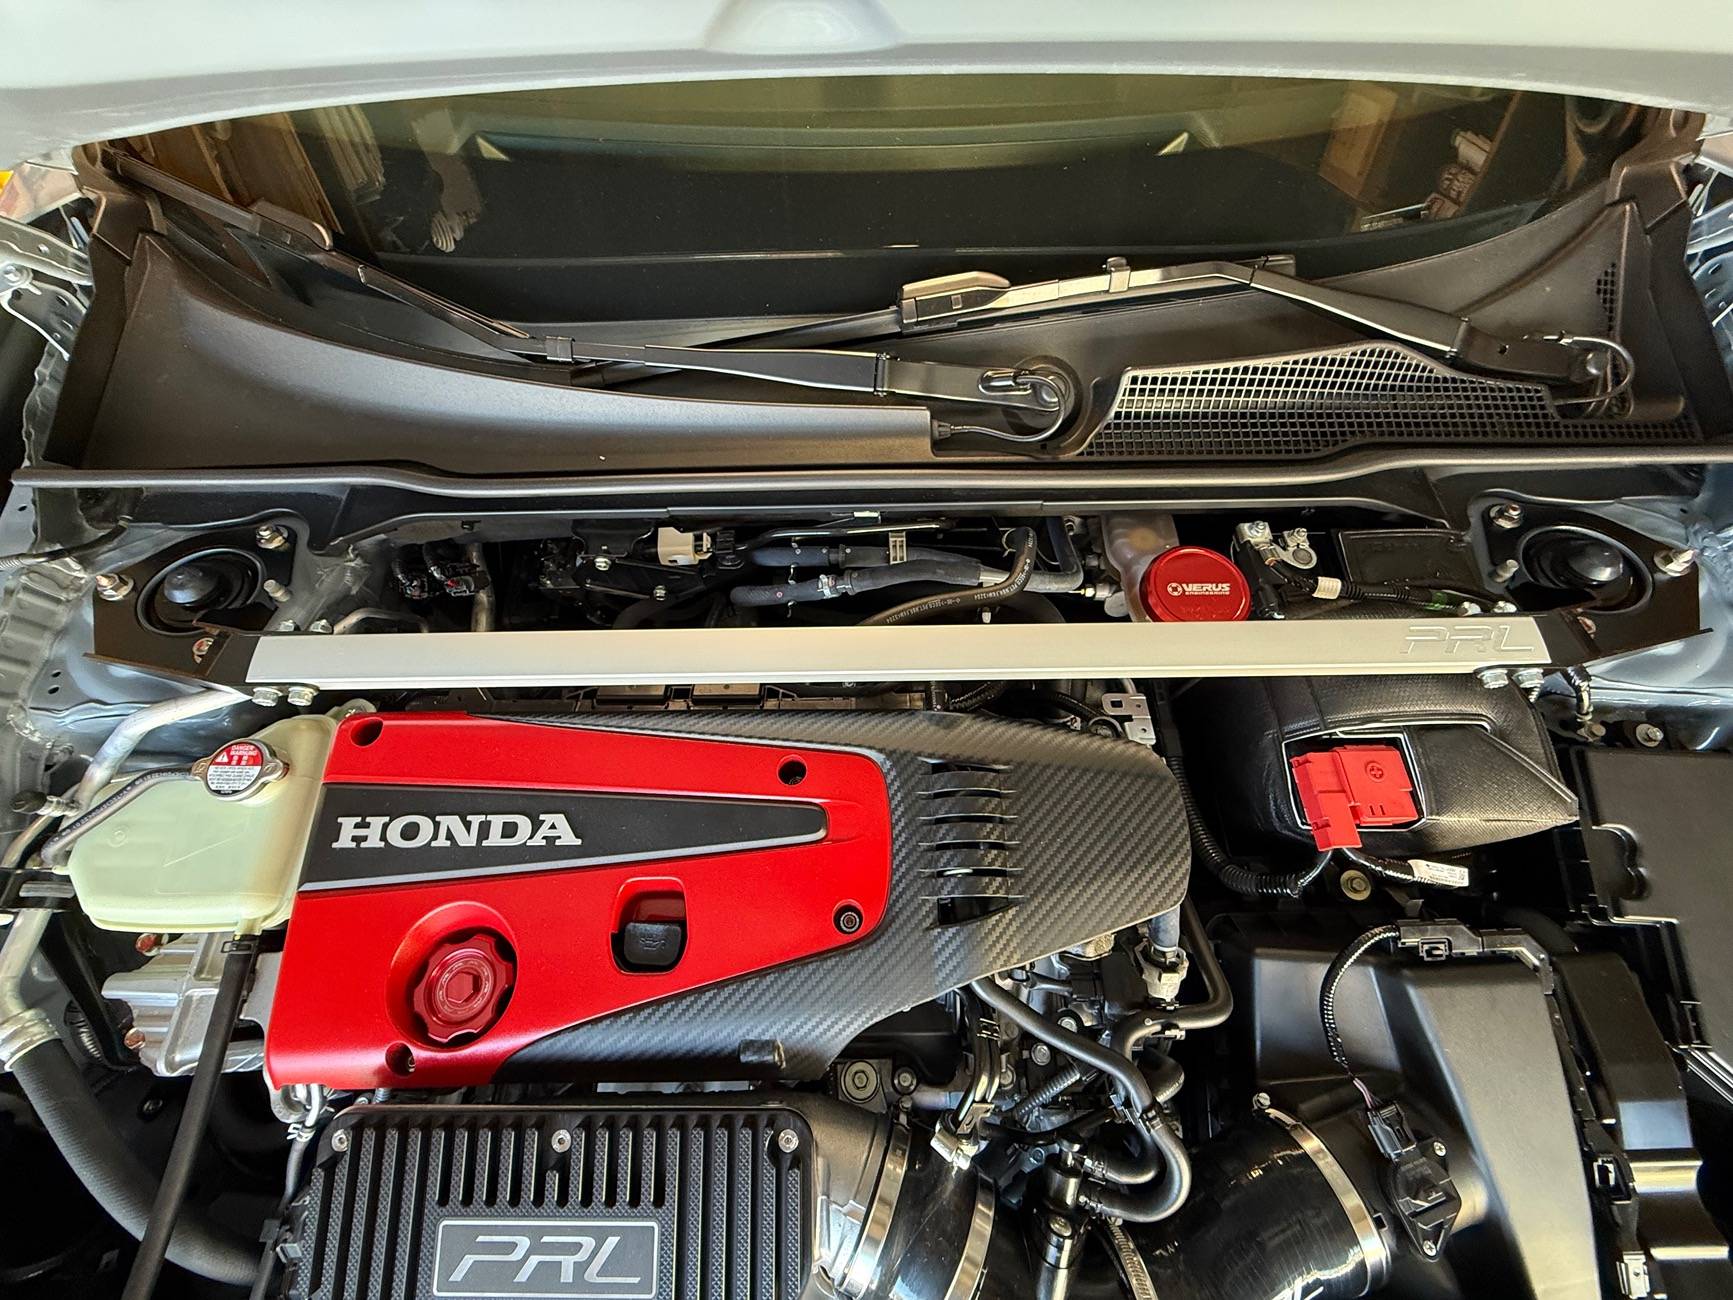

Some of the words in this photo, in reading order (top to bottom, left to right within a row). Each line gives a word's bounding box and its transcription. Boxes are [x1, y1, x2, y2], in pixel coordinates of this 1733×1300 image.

[1181, 583, 1231, 592] VERUS
[1400, 625, 1534, 654] PRL
[331, 813, 582, 848] HONDA
[448, 1235, 641, 1284] PRL
